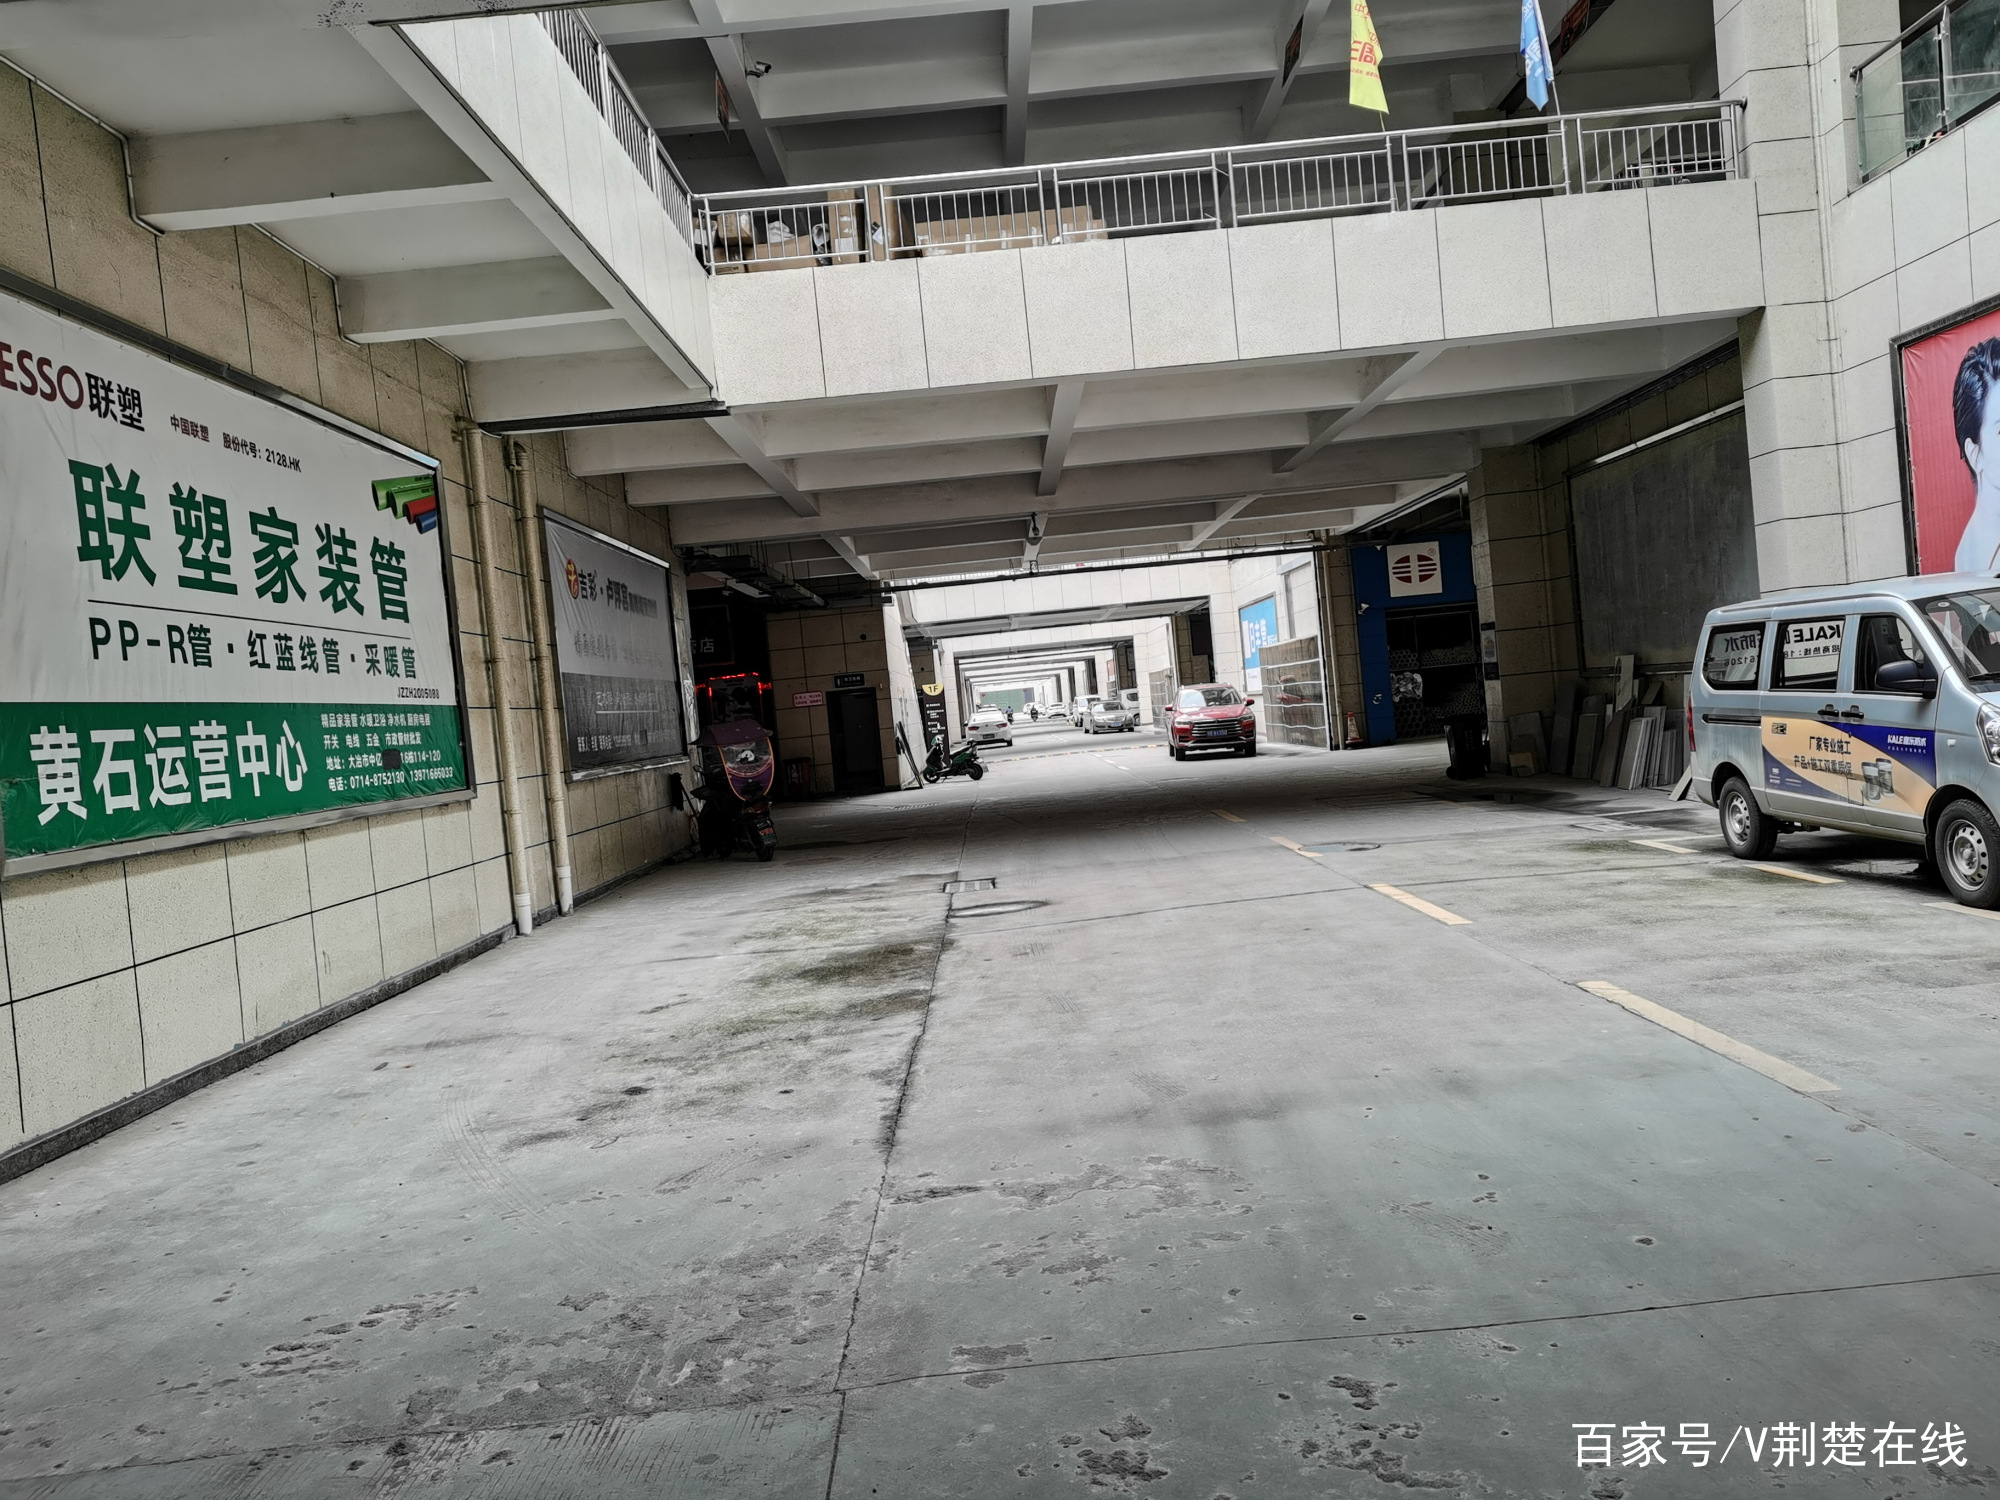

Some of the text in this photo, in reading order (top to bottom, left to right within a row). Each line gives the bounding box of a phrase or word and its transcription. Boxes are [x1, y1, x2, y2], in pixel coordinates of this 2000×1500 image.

[85, 371, 145, 432] 联塑
[170, 414, 210, 443] 中国联塑
[68, 458, 410, 624] 联塑家装管
[928, 685, 939, 693] 1F
[320, 713, 431, 728] 精品家装管 水暖卫浴 净水机 厨房电器
[323, 731, 422, 749] 开关 电线 五金 市政管材批发
[1809, 736, 1851, 755] 厂家专业施工
[30, 719, 308, 826] 黄石运营中心
